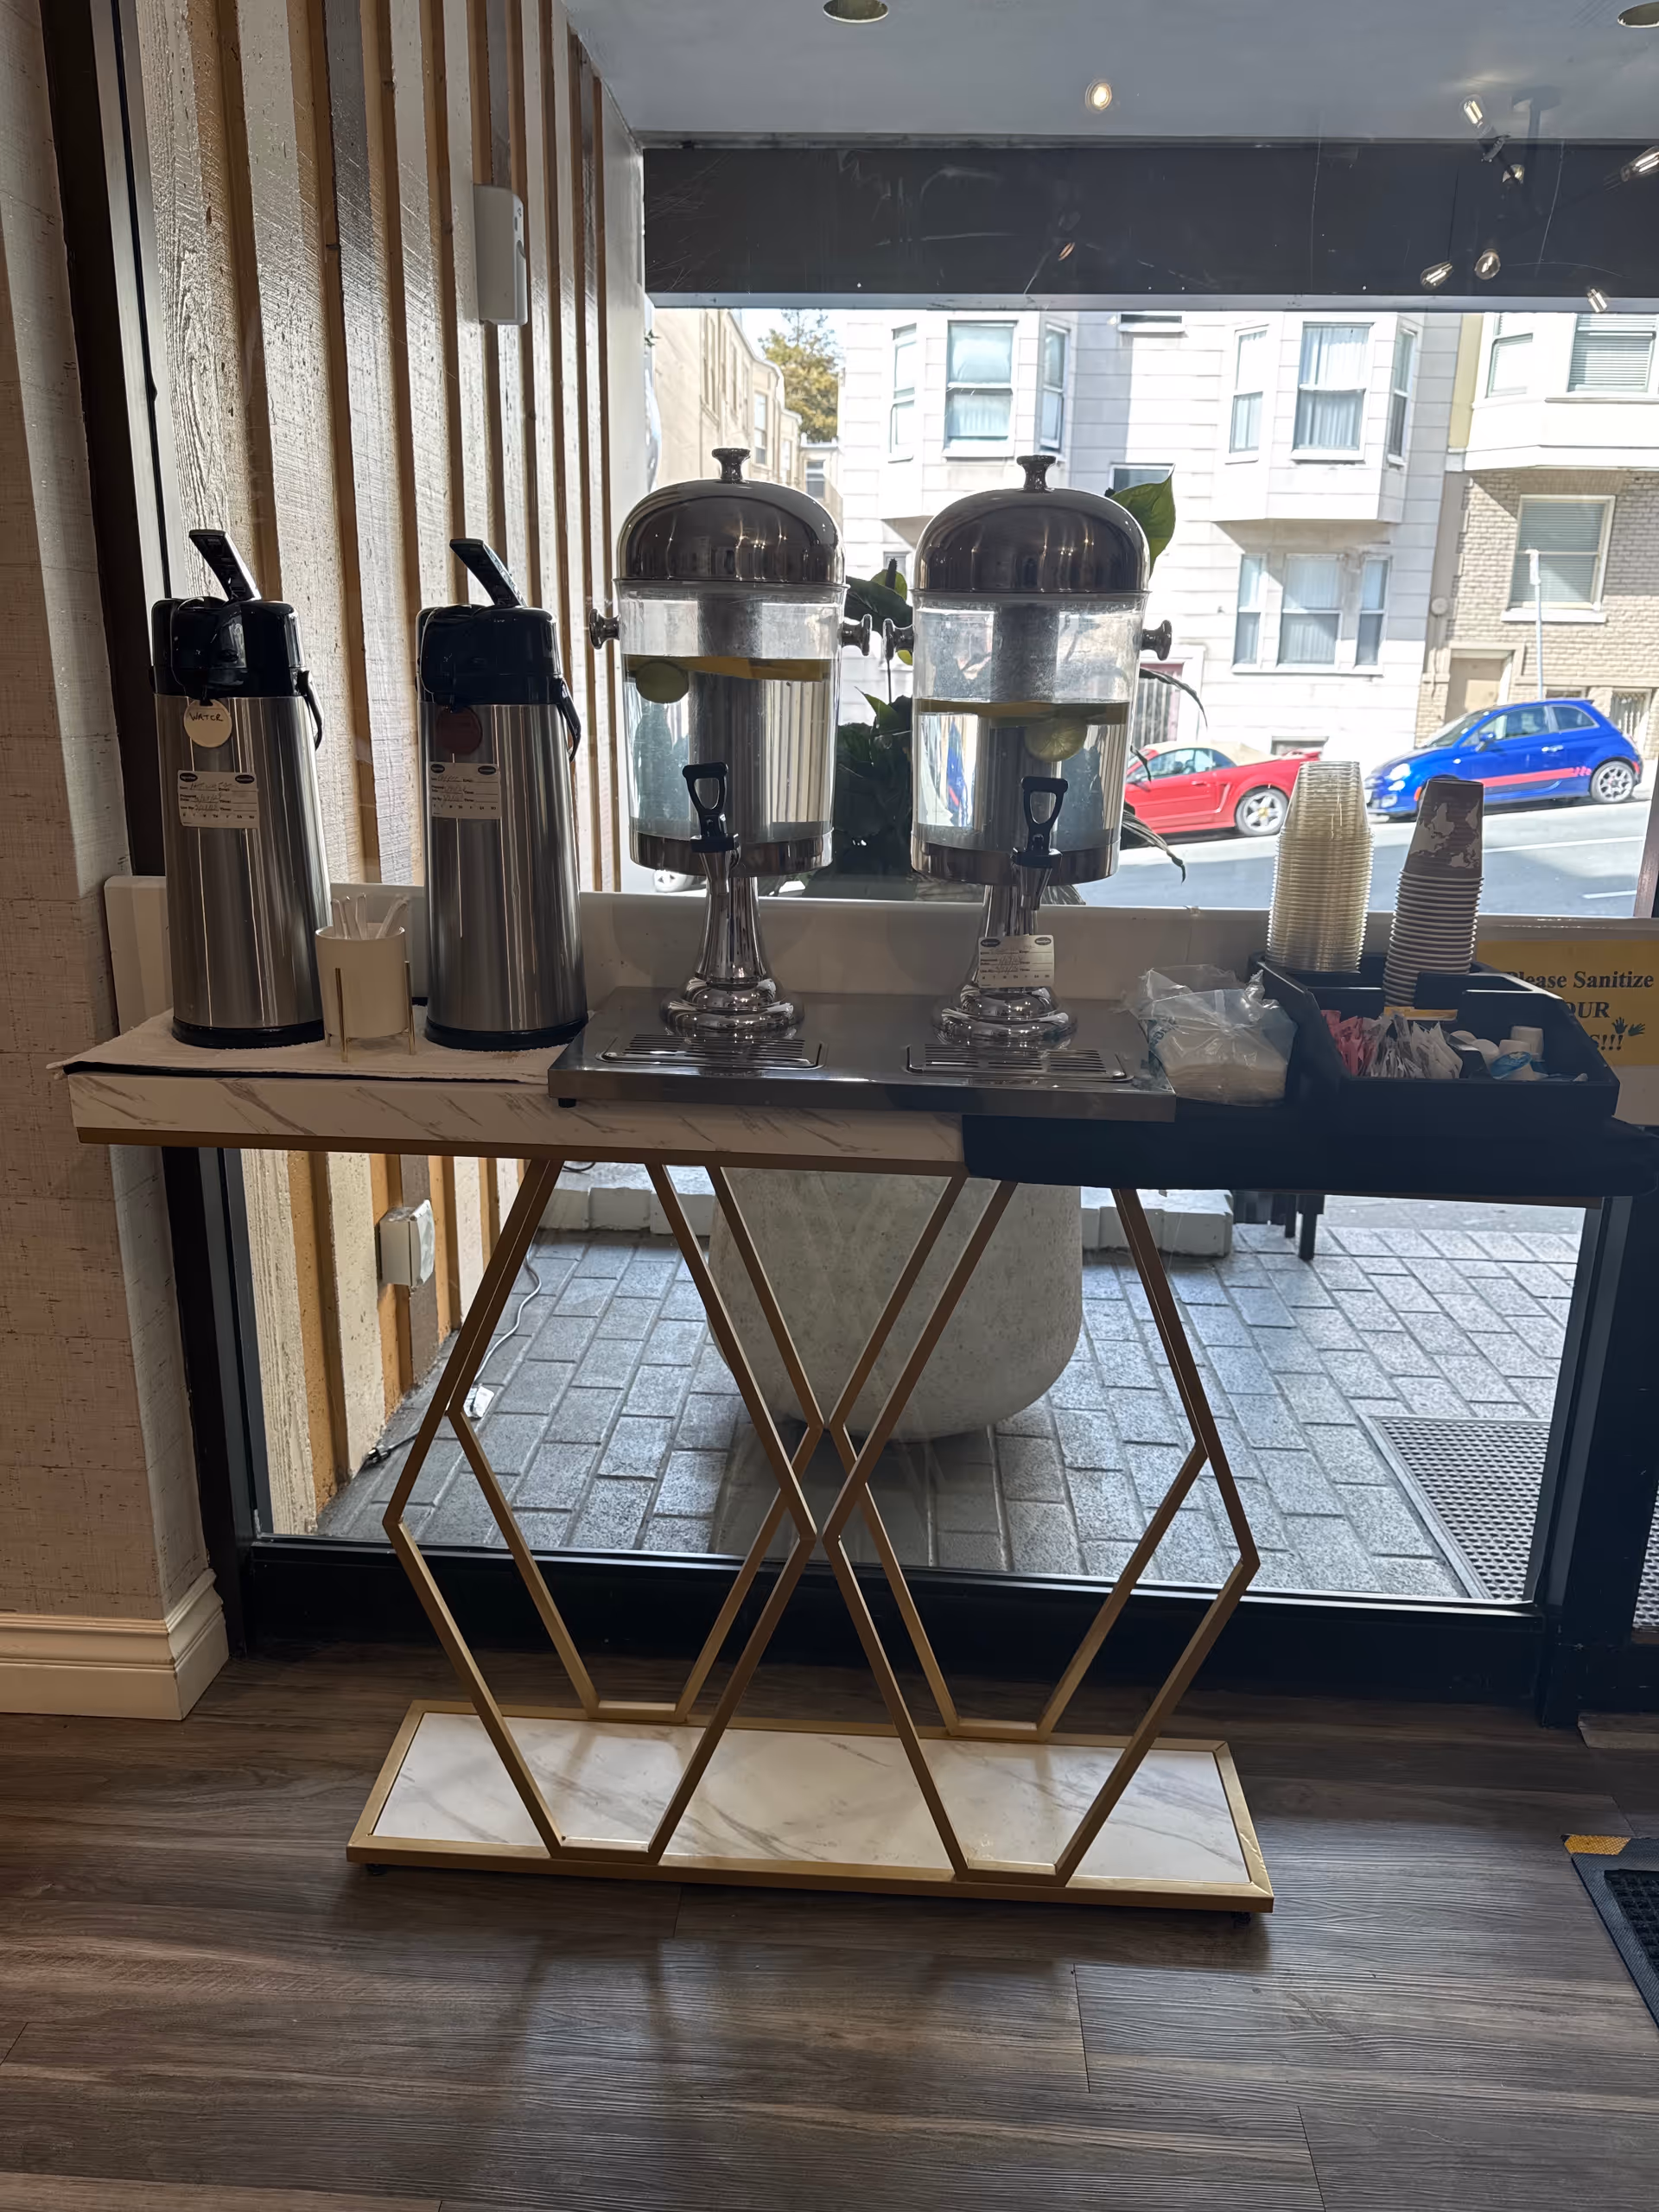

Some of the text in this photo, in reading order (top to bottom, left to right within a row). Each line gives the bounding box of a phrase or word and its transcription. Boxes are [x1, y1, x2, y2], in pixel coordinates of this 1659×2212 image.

[189, 712, 224, 722] WATER
[1573, 970, 1655, 988] Sanitize
[1565, 1001, 1611, 1019] OUR
